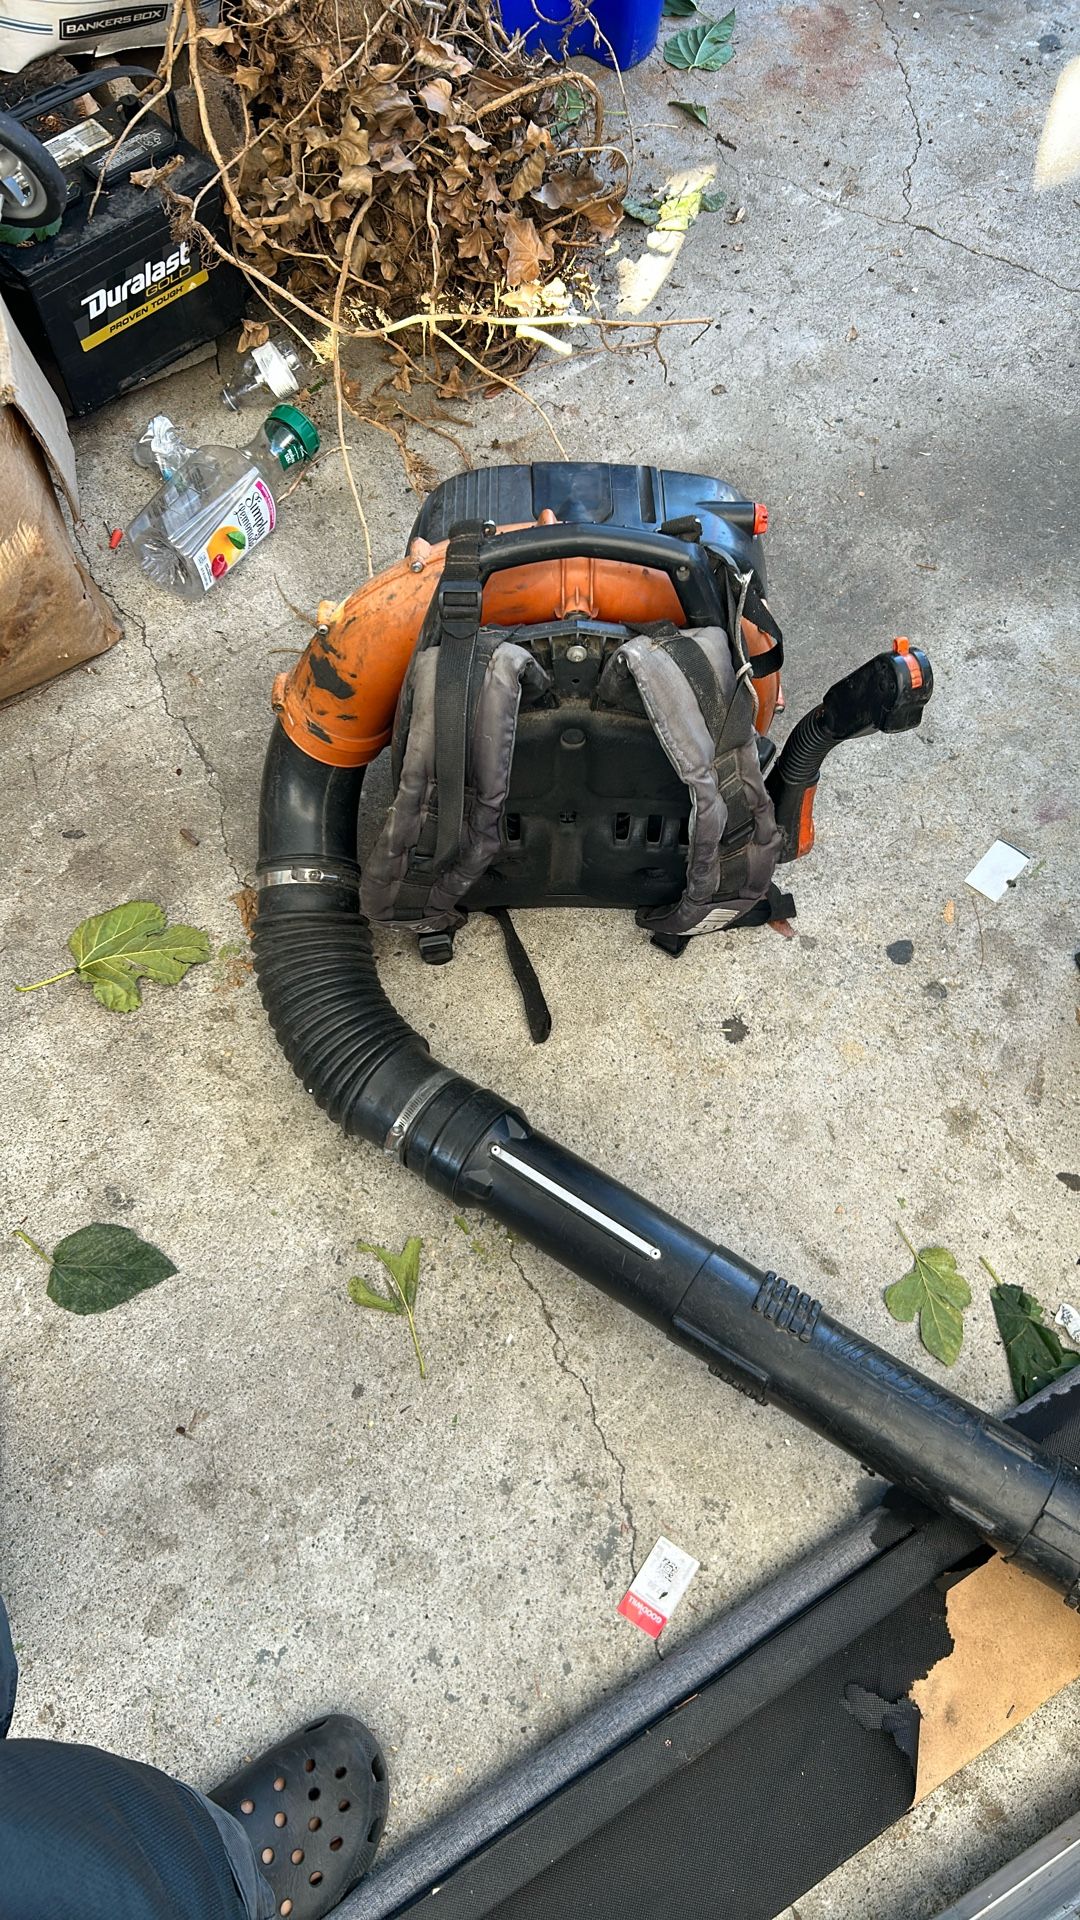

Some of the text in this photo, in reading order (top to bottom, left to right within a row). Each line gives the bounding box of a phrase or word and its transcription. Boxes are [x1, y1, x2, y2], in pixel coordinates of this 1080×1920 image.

[66, 10, 161, 34] BANKERS BOX
[81, 242, 190, 320] Duralast
[146, 266, 191, 297] GOLD
[109, 285, 184, 333] PROVEN TOUGH
[245, 491, 268, 540] Simply
[628, 1595, 662, 1624] GOODWILL
